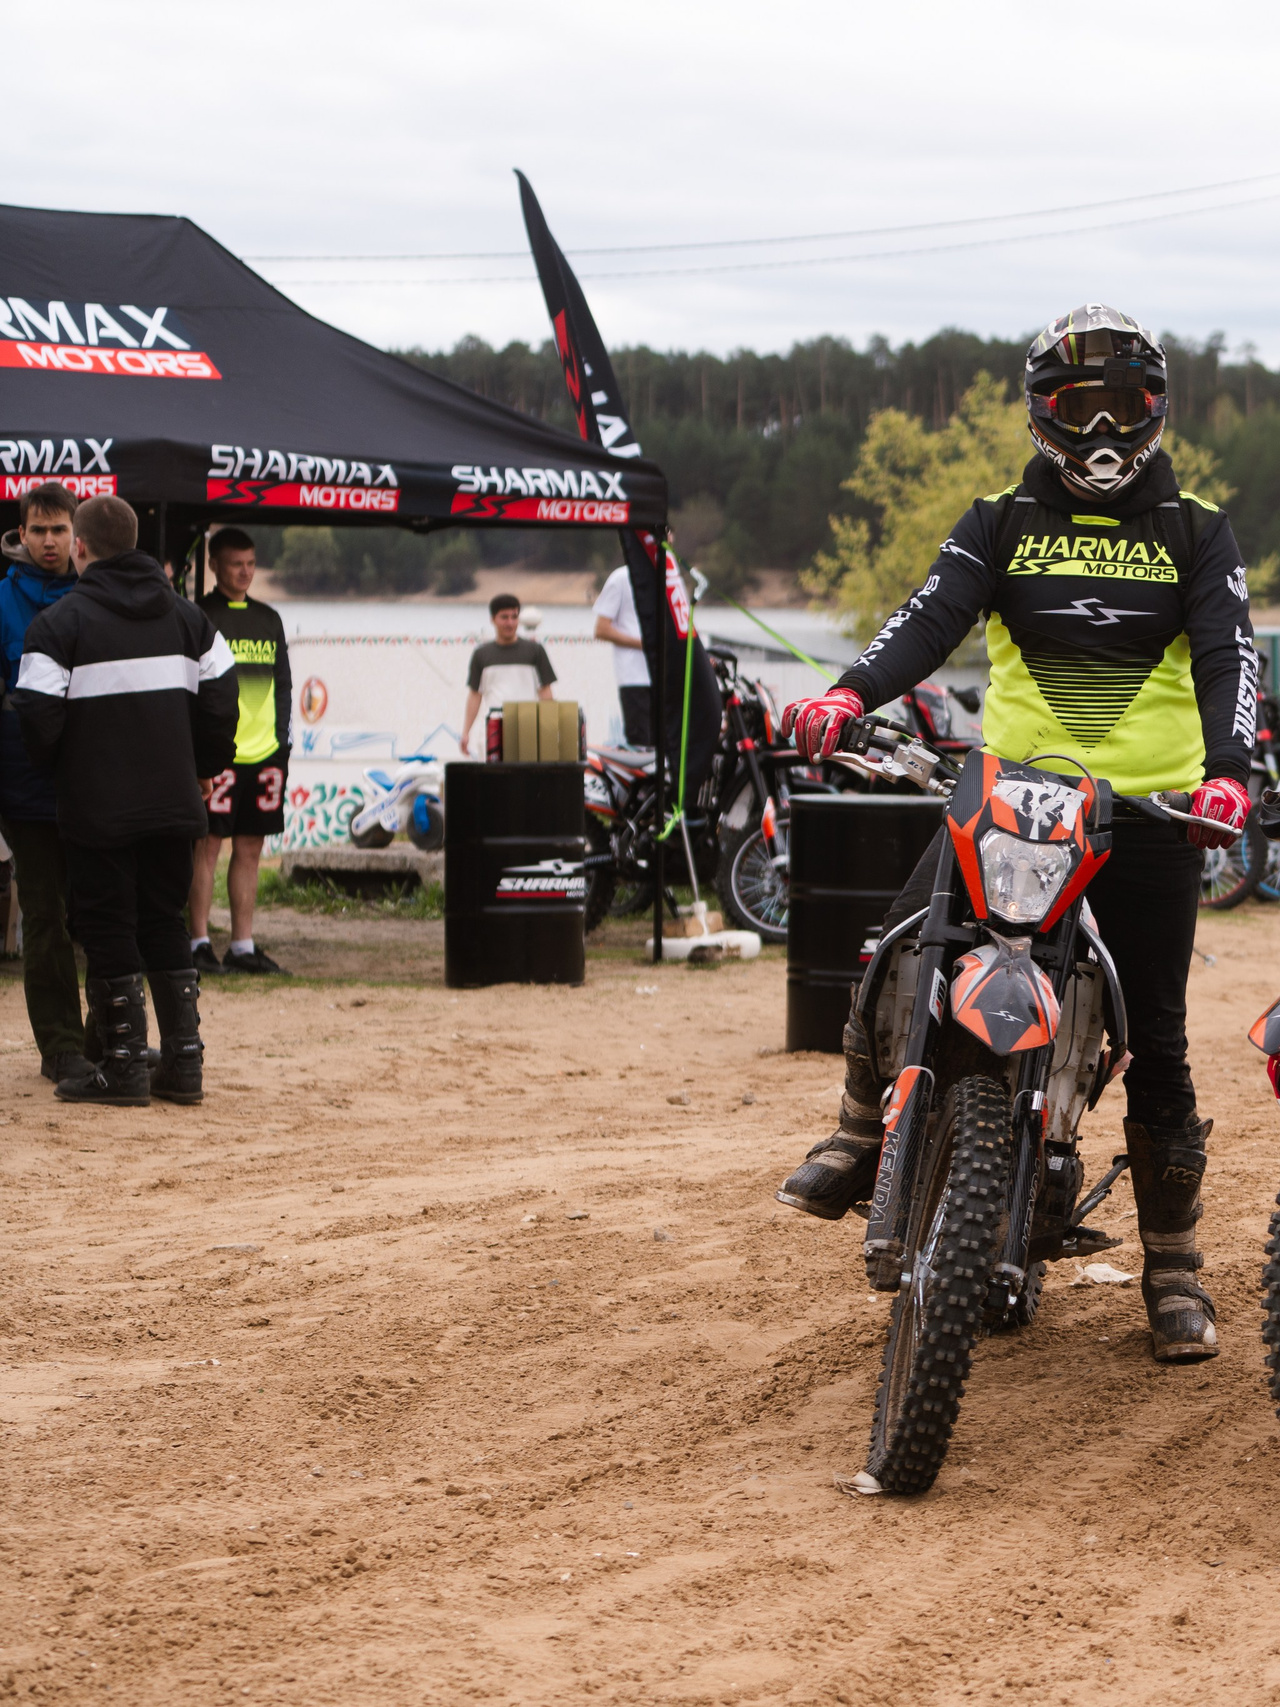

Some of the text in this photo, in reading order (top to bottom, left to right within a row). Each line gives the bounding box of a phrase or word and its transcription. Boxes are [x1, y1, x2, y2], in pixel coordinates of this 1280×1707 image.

[16, 343, 212, 377] MOTORS
[451, 455, 627, 500] SHARMAX
[300, 485, 397, 511] MOTORS
[537, 500, 628, 523] MOTORS
[1082, 562, 1176, 581] MOTORS
[210, 767, 283, 813] 2 3
[870, 1130, 900, 1225] KENDA
